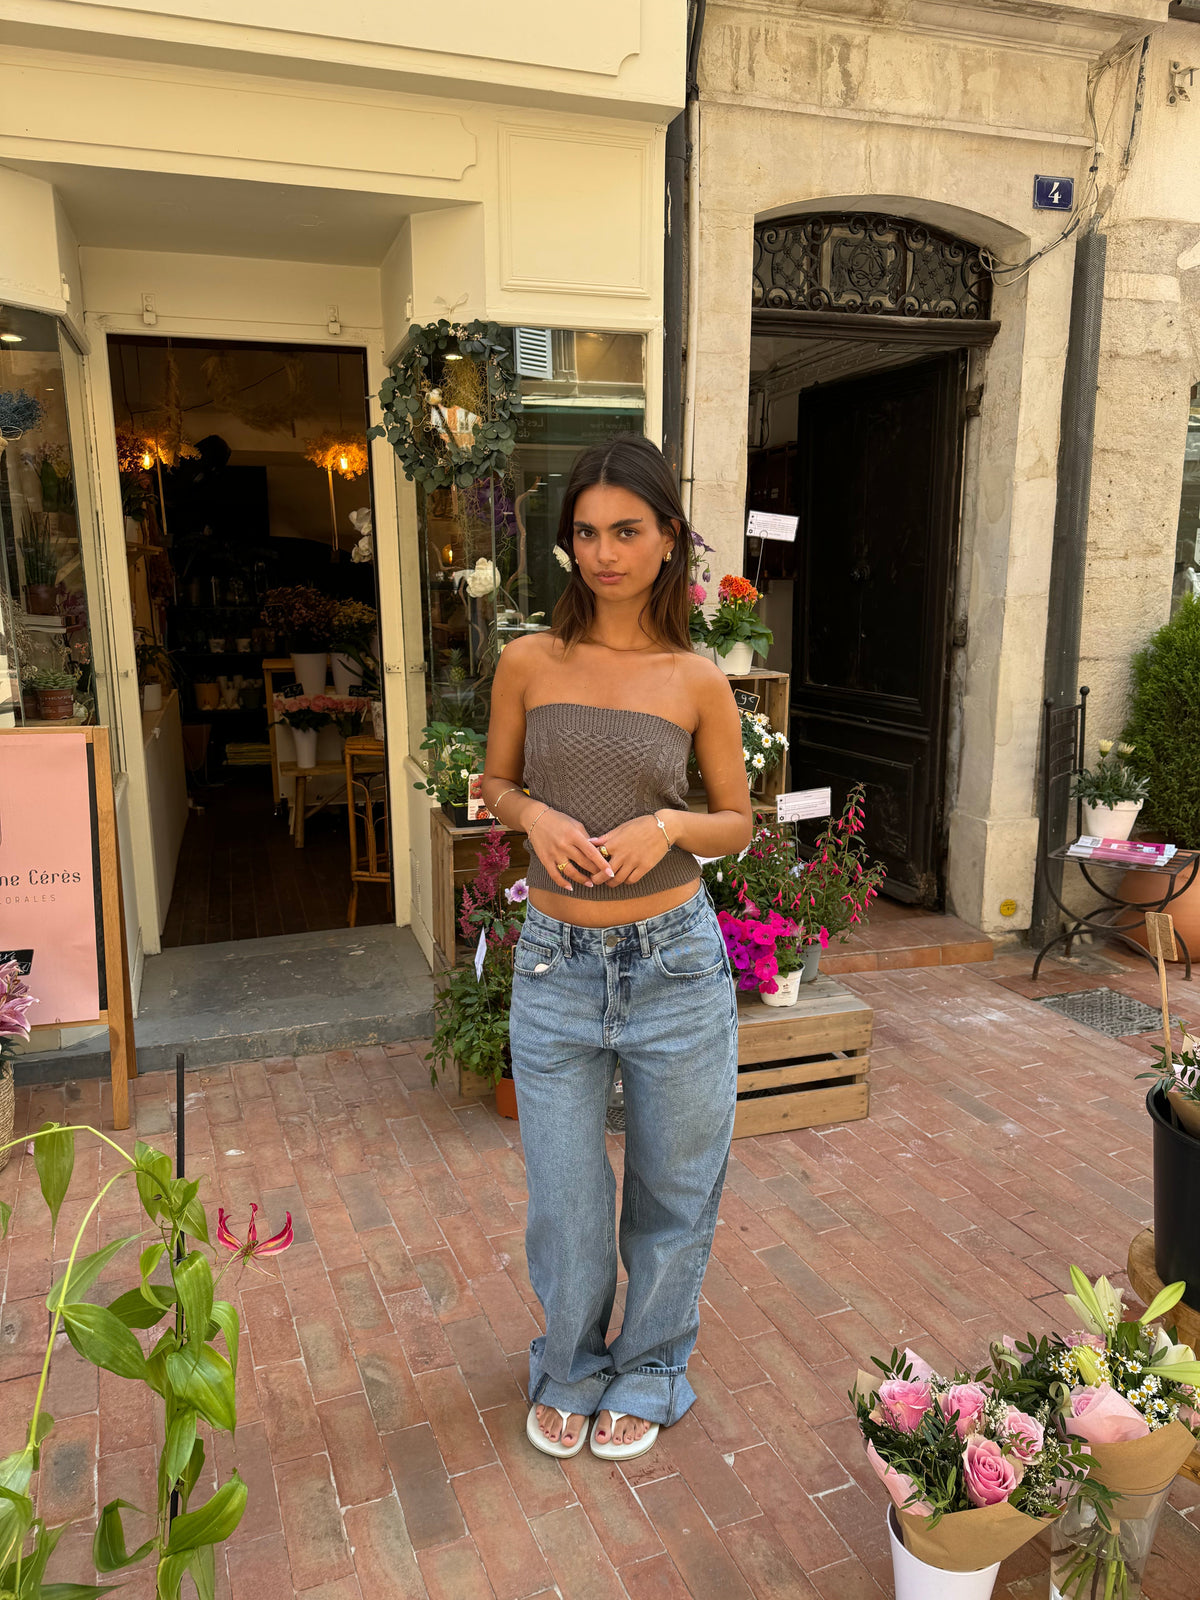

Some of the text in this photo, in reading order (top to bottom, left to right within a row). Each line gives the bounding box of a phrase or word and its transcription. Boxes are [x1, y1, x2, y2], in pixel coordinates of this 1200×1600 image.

[1048, 181, 1062, 204] 4
[29, 869, 81, 885] Cérès
[0, 894, 56, 904] ORALES
